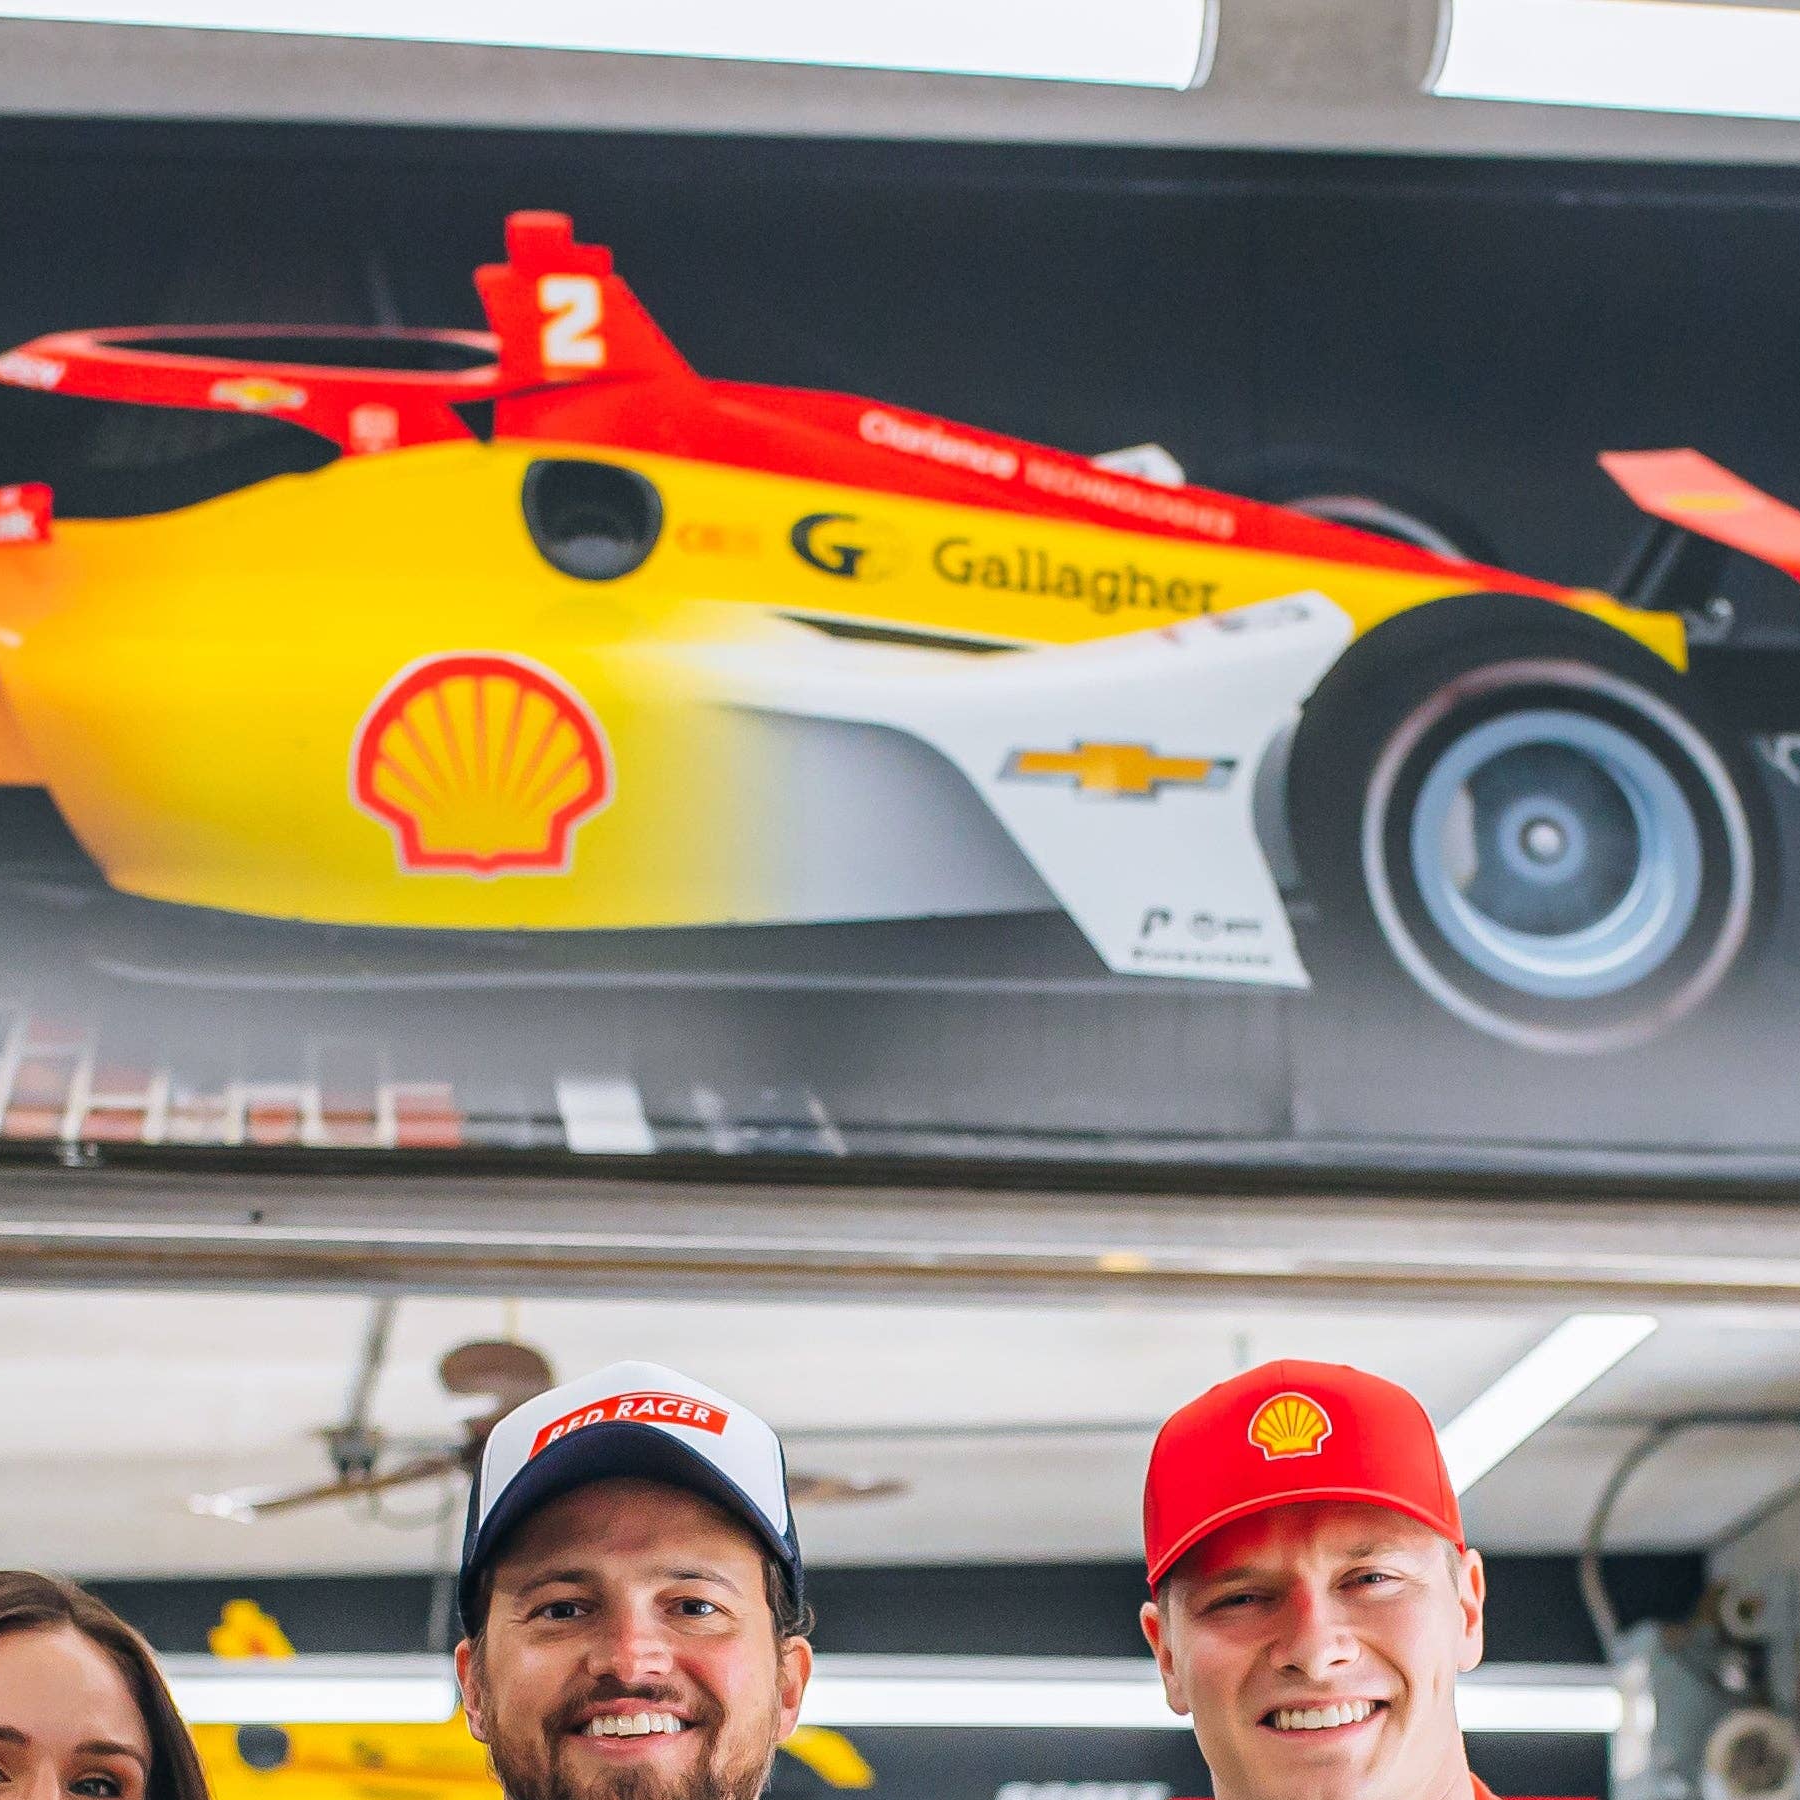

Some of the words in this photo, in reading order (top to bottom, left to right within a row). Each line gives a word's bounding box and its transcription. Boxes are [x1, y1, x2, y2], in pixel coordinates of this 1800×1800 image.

[537, 273, 605, 368] 2
[931, 536, 1221, 615] Gallagher
[546, 1408, 604, 1444] RED
[614, 1398, 711, 1425] RACER
